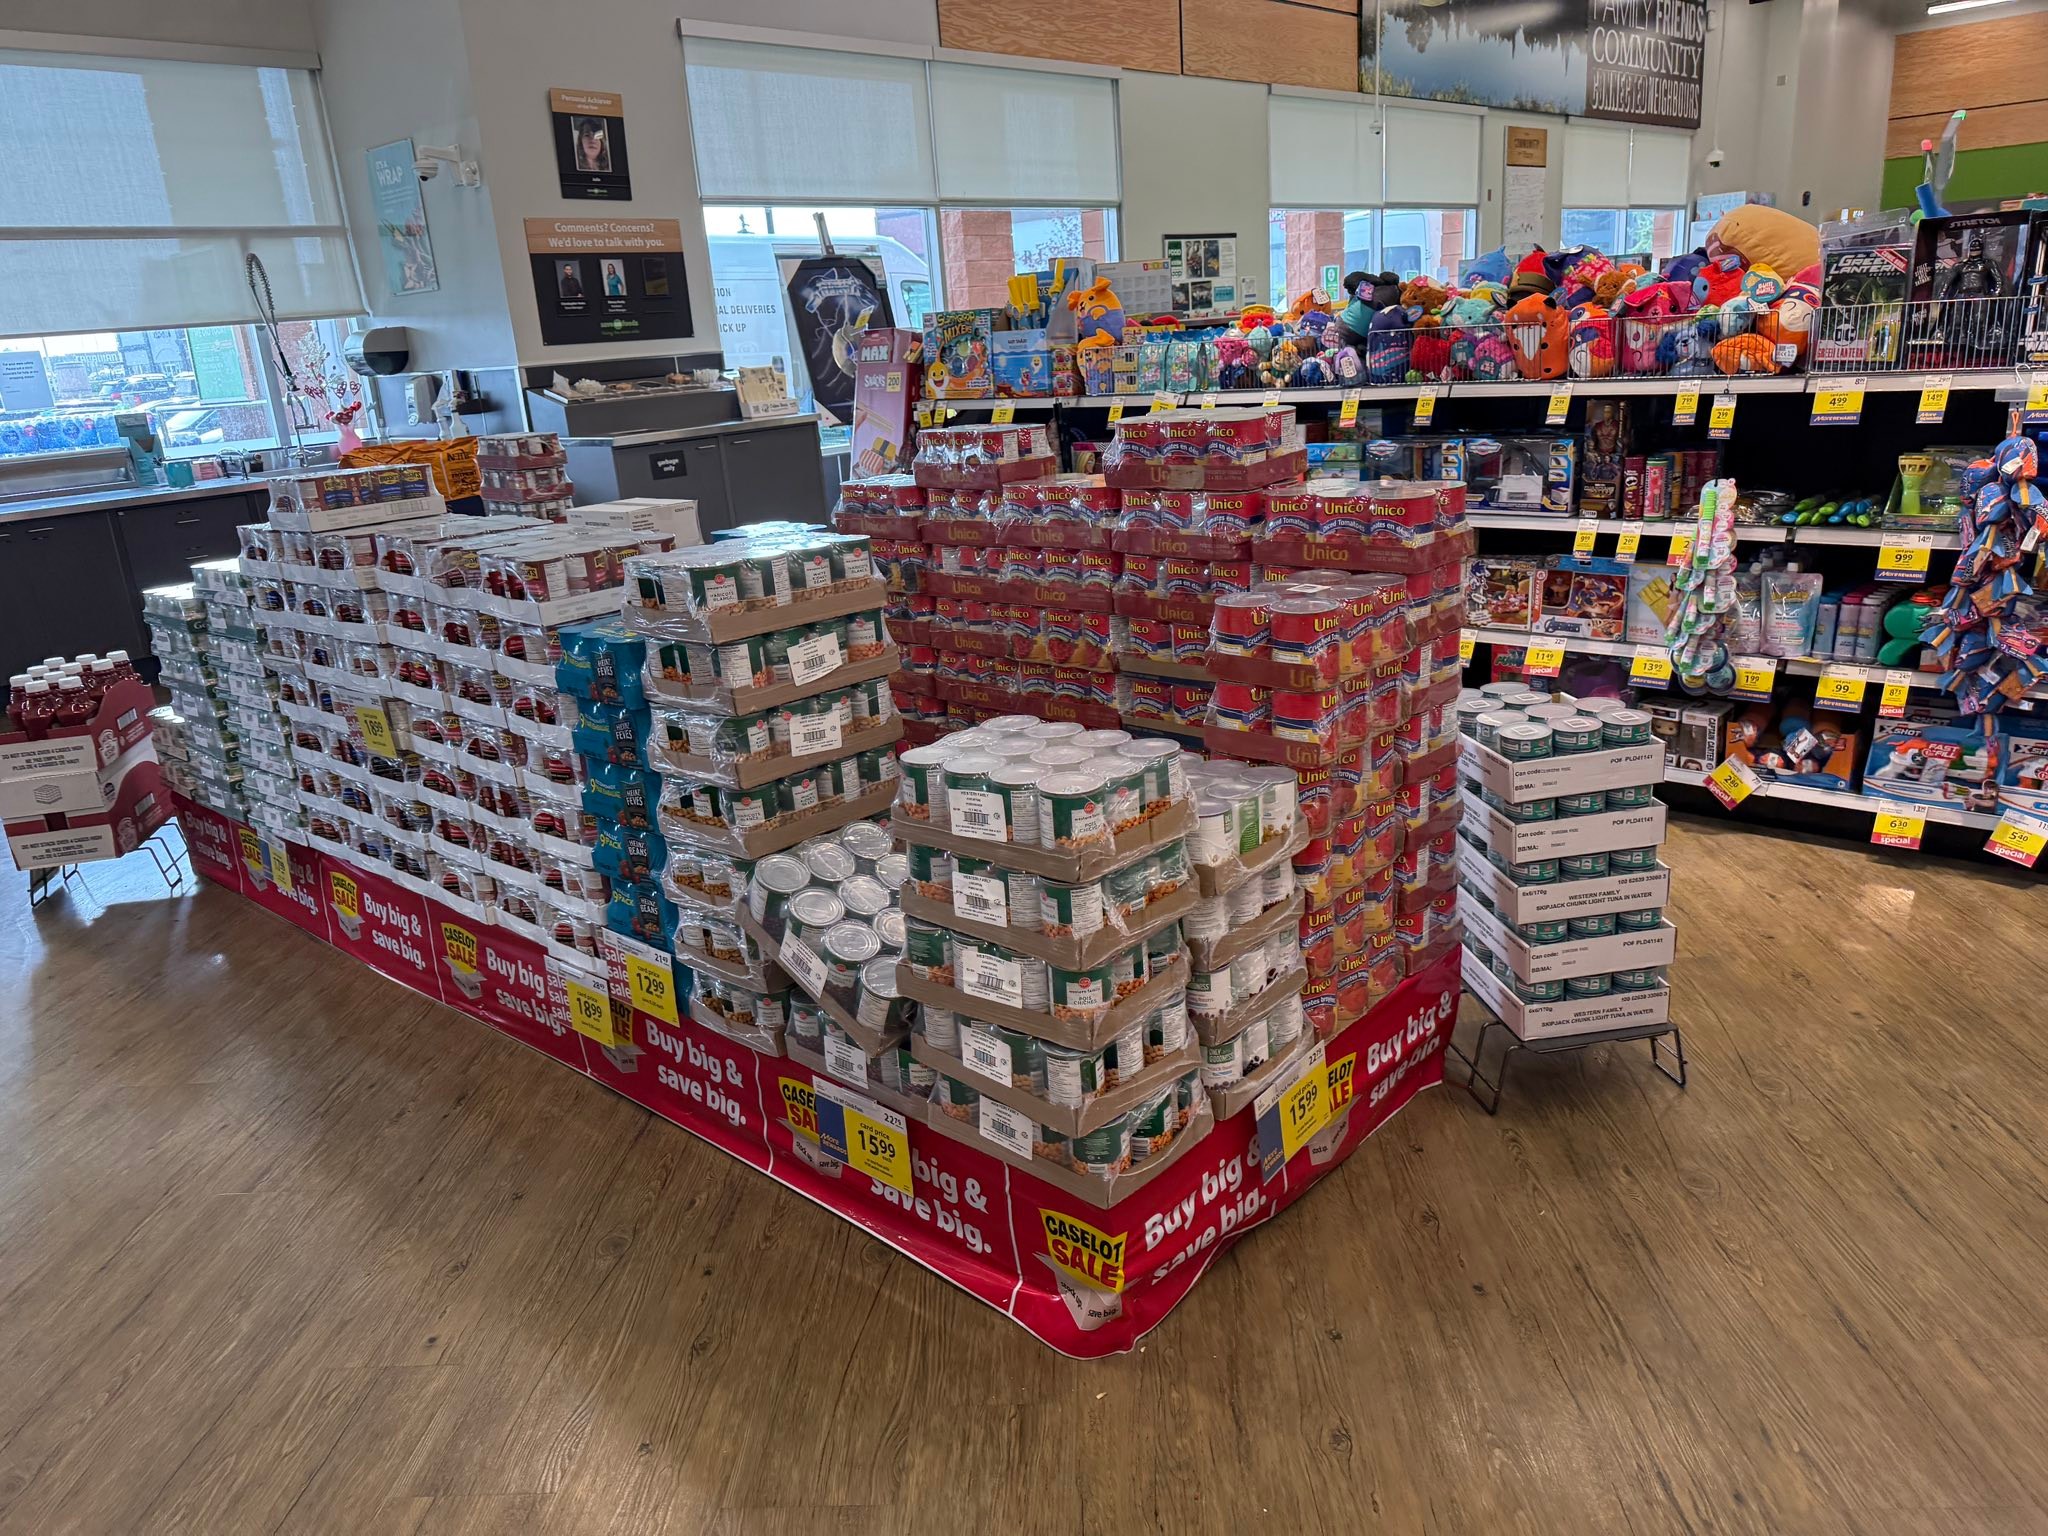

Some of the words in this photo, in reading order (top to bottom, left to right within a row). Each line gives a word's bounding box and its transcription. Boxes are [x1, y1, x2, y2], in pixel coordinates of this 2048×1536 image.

[1656, 0, 1704, 42] FRIENDS
[1592, 26, 1702, 78] COMMUNITY
[1648, 76, 1699, 119] NEIGHBOURS
[377, 167, 402, 186] WRAP
[554, 222, 608, 232] Comments?
[610, 223, 654, 232] Concerns?
[548, 237, 572, 247] We'd
[573, 238, 592, 247] love
[593, 238, 604, 246] to
[605, 238, 623, 246] talk
[624, 238, 644, 246] with
[645, 239, 664, 248] you.
[730, 304, 776, 315] DELIVERIES
[736, 323, 747, 333] UP
[861, 344, 888, 362] MAX
[888, 376, 899, 387] 200
[1681, 395, 1695, 405] 799
[1828, 397, 1847, 407] 499
[1716, 411, 1728, 419] 299
[657, 457, 679, 467] garbage
[663, 464, 675, 472] only
[1208, 498, 1243, 511] Unico
[1271, 501, 1308, 513] Unico
[1324, 503, 1364, 516] Unico
[1226, 515, 1236, 523] en
[1236, 519, 1245, 528] dés
[1282, 516, 1310, 531] Tomatoes
[1322, 521, 1338, 534] Diced
[1338, 519, 1365, 533] Tomatoes
[1386, 522, 1395, 530] en
[1082, 554, 1112, 565] Unico
[1303, 544, 1349, 561] Unico
[1894, 553, 1913, 563] 999
[1034, 588, 1066, 601] Unico
[1313, 615, 1340, 632] Unic
[1376, 607, 1399, 627] Crushed
[1347, 620, 1367, 639] Crushed
[954, 636, 983, 650] Unico
[1307, 635, 1330, 653] Crushed
[1535, 651, 1554, 661] 1149
[1642, 662, 1662, 672] 1399
[1744, 675, 1760, 683] 199
[1371, 679, 1396, 696] Tomates
[1889, 688, 1901, 696] 875
[1879, 706, 1904, 714] special
[1707, 718, 1716, 740] CAPTAIN
[1707, 741, 1715, 768] CARTER
[1928, 743, 1960, 751] FAST
[1935, 750, 1958, 758] FILL
[1624, 754, 1653, 762] PLD41141
[1723, 775, 1739, 788] 280
[626, 788, 640, 798] HEINZ
[1889, 820, 1907, 828] 630
[628, 839, 644, 848] HEINZ
[1880, 836, 1911, 844] special
[2009, 832, 2028, 842] 540
[628, 846, 647, 856] BEANS
[1993, 845, 2026, 859] special
[297, 886, 319, 916] big.
[333, 888, 358, 914] SALE
[1566, 901, 1587, 909] CHUNK
[1606, 896, 1623, 904] TUNA
[1631, 891, 1652, 899] WATER
[1568, 892, 1598, 900] WESTERN
[1600, 889, 1621, 897] FAMILY
[363, 892, 388, 927] Buy
[389, 907, 410, 937] big
[410, 916, 423, 938] &
[640, 904, 658, 915] BEANS
[443, 926, 477, 949] CASELOT
[372, 928, 399, 952] save
[400, 937, 427, 971] big.
[448, 942, 477, 969] SALE
[605, 948, 626, 964] sale
[485, 945, 517, 986] Buy
[518, 958, 545, 999] big
[608, 965, 629, 981] sale
[547, 975, 567, 989] sale
[636, 972, 664, 995] 1299
[1300, 977, 1332, 995] Unico
[610, 982, 632, 999] sale
[495, 987, 531, 1019] save
[550, 991, 570, 1006] sale
[551, 1006, 572, 1022] sale
[577, 997, 602, 1018] 1899
[1573, 1009, 1599, 1017] WESTERN
[1600, 1006, 1623, 1014] FAMILY
[1541, 1019, 1570, 1027] SKIPJACK
[1366, 1026, 1405, 1075] Buy
[1406, 1007, 1437, 1044] big
[1437, 991, 1453, 1019] &
[644, 1018, 684, 1064] Buy
[687, 1045, 722, 1084] big
[725, 1058, 744, 1089] &
[658, 1064, 702, 1103] save
[706, 1086, 747, 1127] big.
[1291, 1087, 1302, 1102] card
[1302, 1080, 1314, 1094] price
[1290, 1085, 1317, 1126] 1599
[884, 1113, 901, 1125] 2279
[860, 1122, 873, 1133] card
[875, 1128, 890, 1140] price
[820, 1133, 840, 1145] More
[858, 1130, 895, 1159] 1599
[912, 1147, 959, 1204] big
[964, 1177, 990, 1214] &
[1143, 1190, 1197, 1252] Buy
[1201, 1154, 1242, 1205] big
[932, 1198, 992, 1254] big.
[1045, 1215, 1124, 1264] CASELOT
[1151, 1225, 1216, 1286] save
[1220, 1186, 1268, 1234] big.
[1051, 1239, 1121, 1289] SALE
[1060, 1281, 1076, 1301] stock
